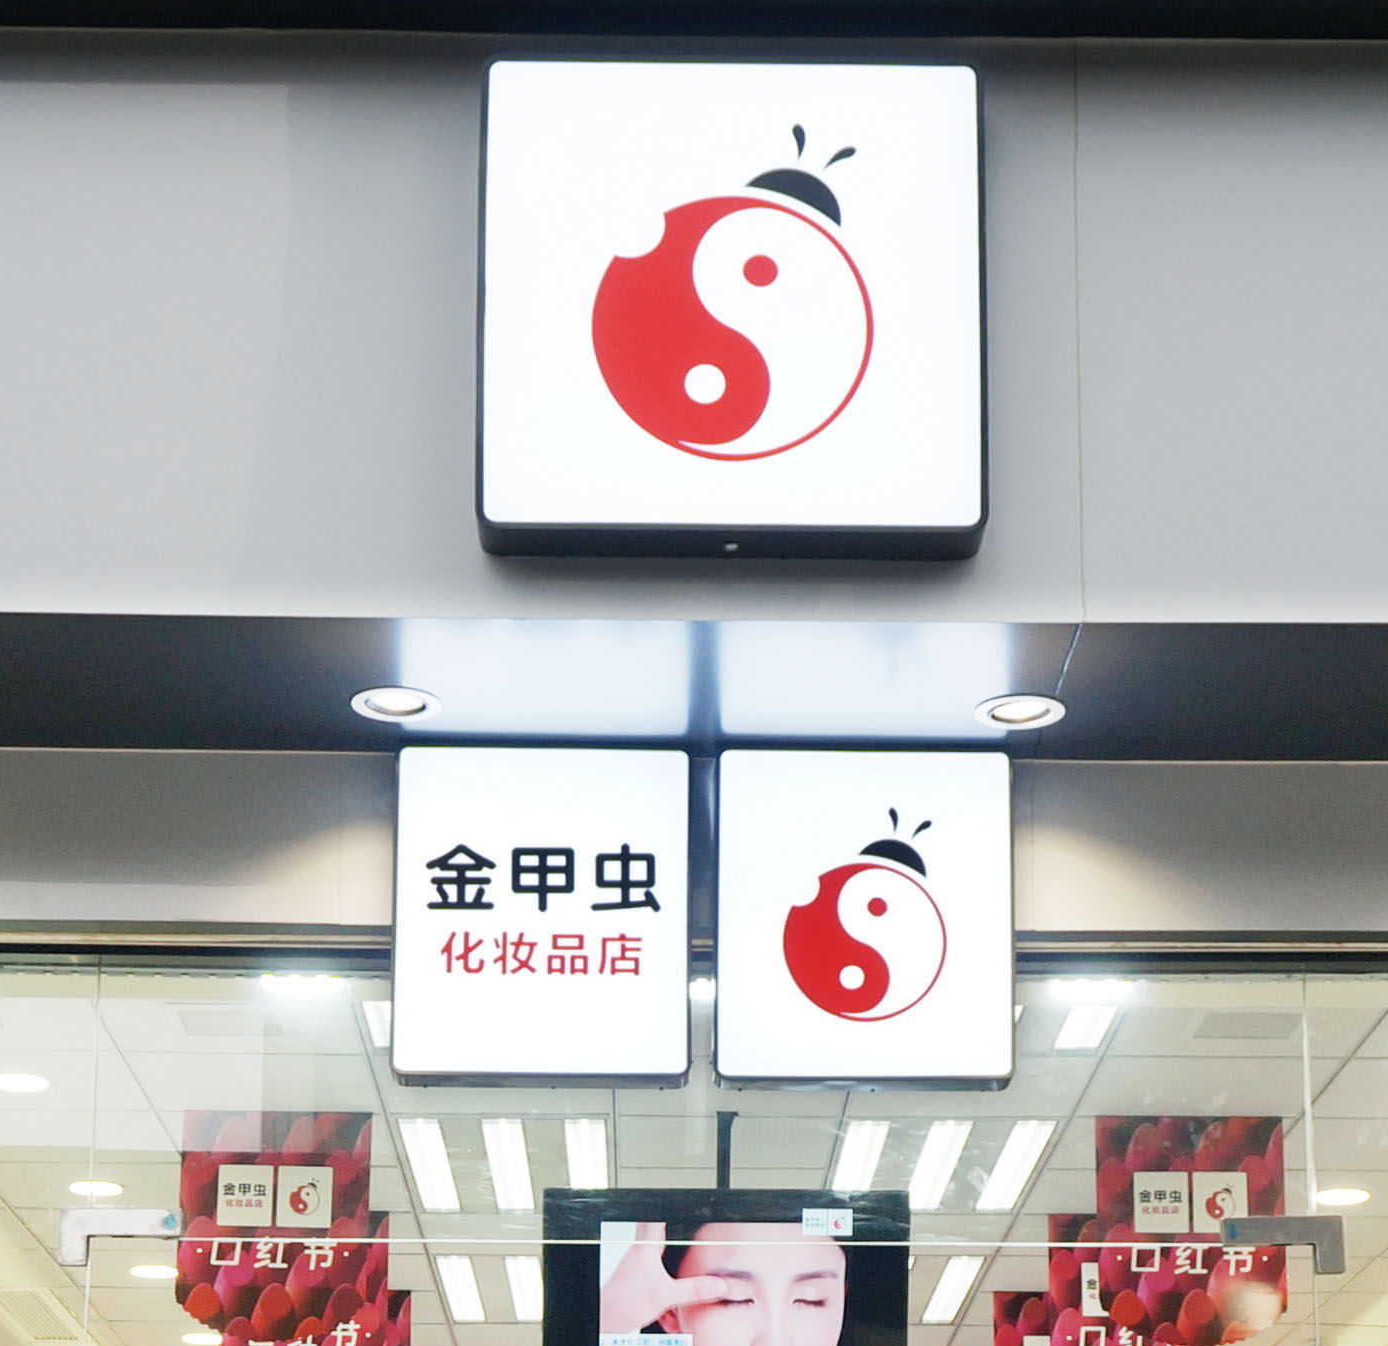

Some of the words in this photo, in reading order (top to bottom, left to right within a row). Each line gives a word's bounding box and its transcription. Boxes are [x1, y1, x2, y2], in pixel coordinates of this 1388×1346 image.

[426, 842, 662, 913] 金甲虫
[440, 931, 643, 976] 化妆品店
[222, 1182, 267, 1197] 金甲虫
[1138, 1188, 1183, 1204] 金甲虫
[209, 1236, 339, 1271] 口红节
[1130, 1246, 1255, 1275] 口红节
